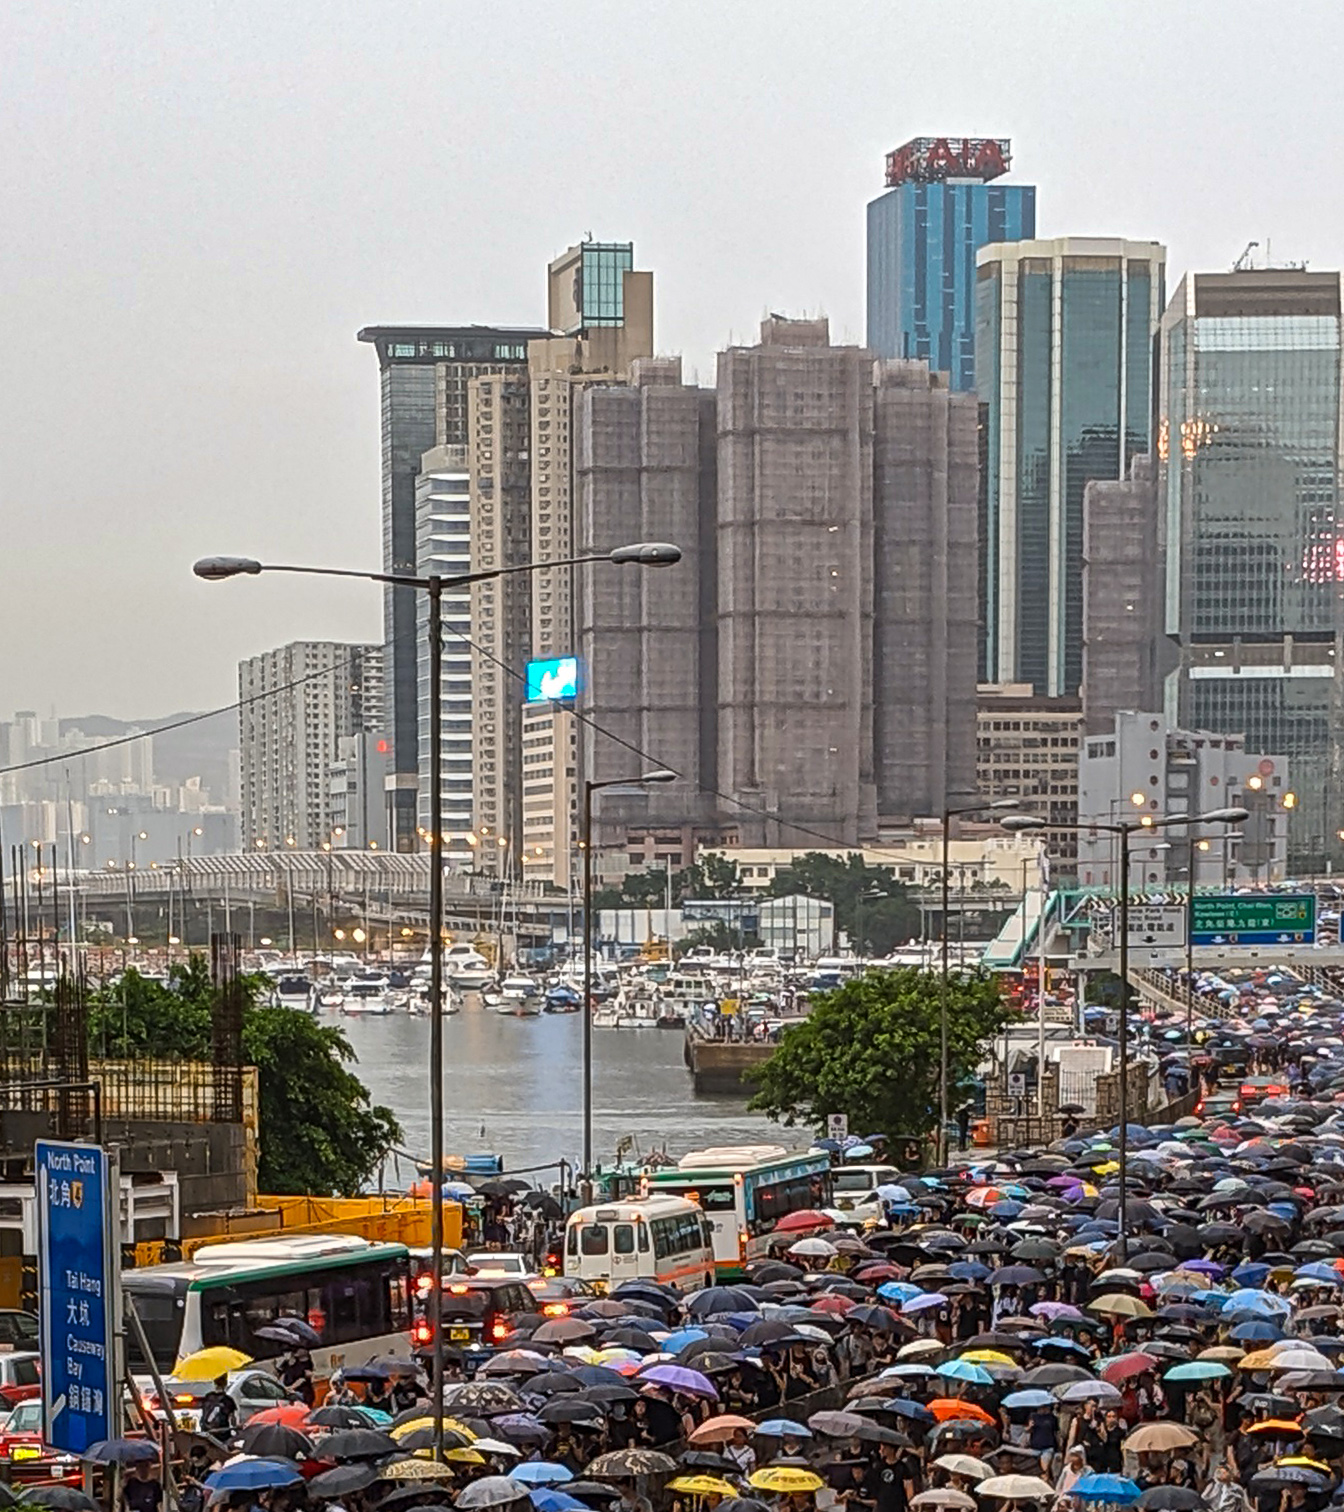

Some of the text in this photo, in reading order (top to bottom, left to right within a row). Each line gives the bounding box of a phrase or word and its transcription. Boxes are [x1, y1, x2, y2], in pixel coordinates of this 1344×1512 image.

[47, 1151, 96, 1175] North Point
[49, 1178, 71, 1208] 北角
[66, 1270, 101, 1298] Tai Hang
[67, 1297, 90, 1327] 大坑
[67, 1333, 105, 1361] Causeway
[67, 1356, 83, 1381] Bay
[68, 1383, 104, 1417] 銅鑼灣
